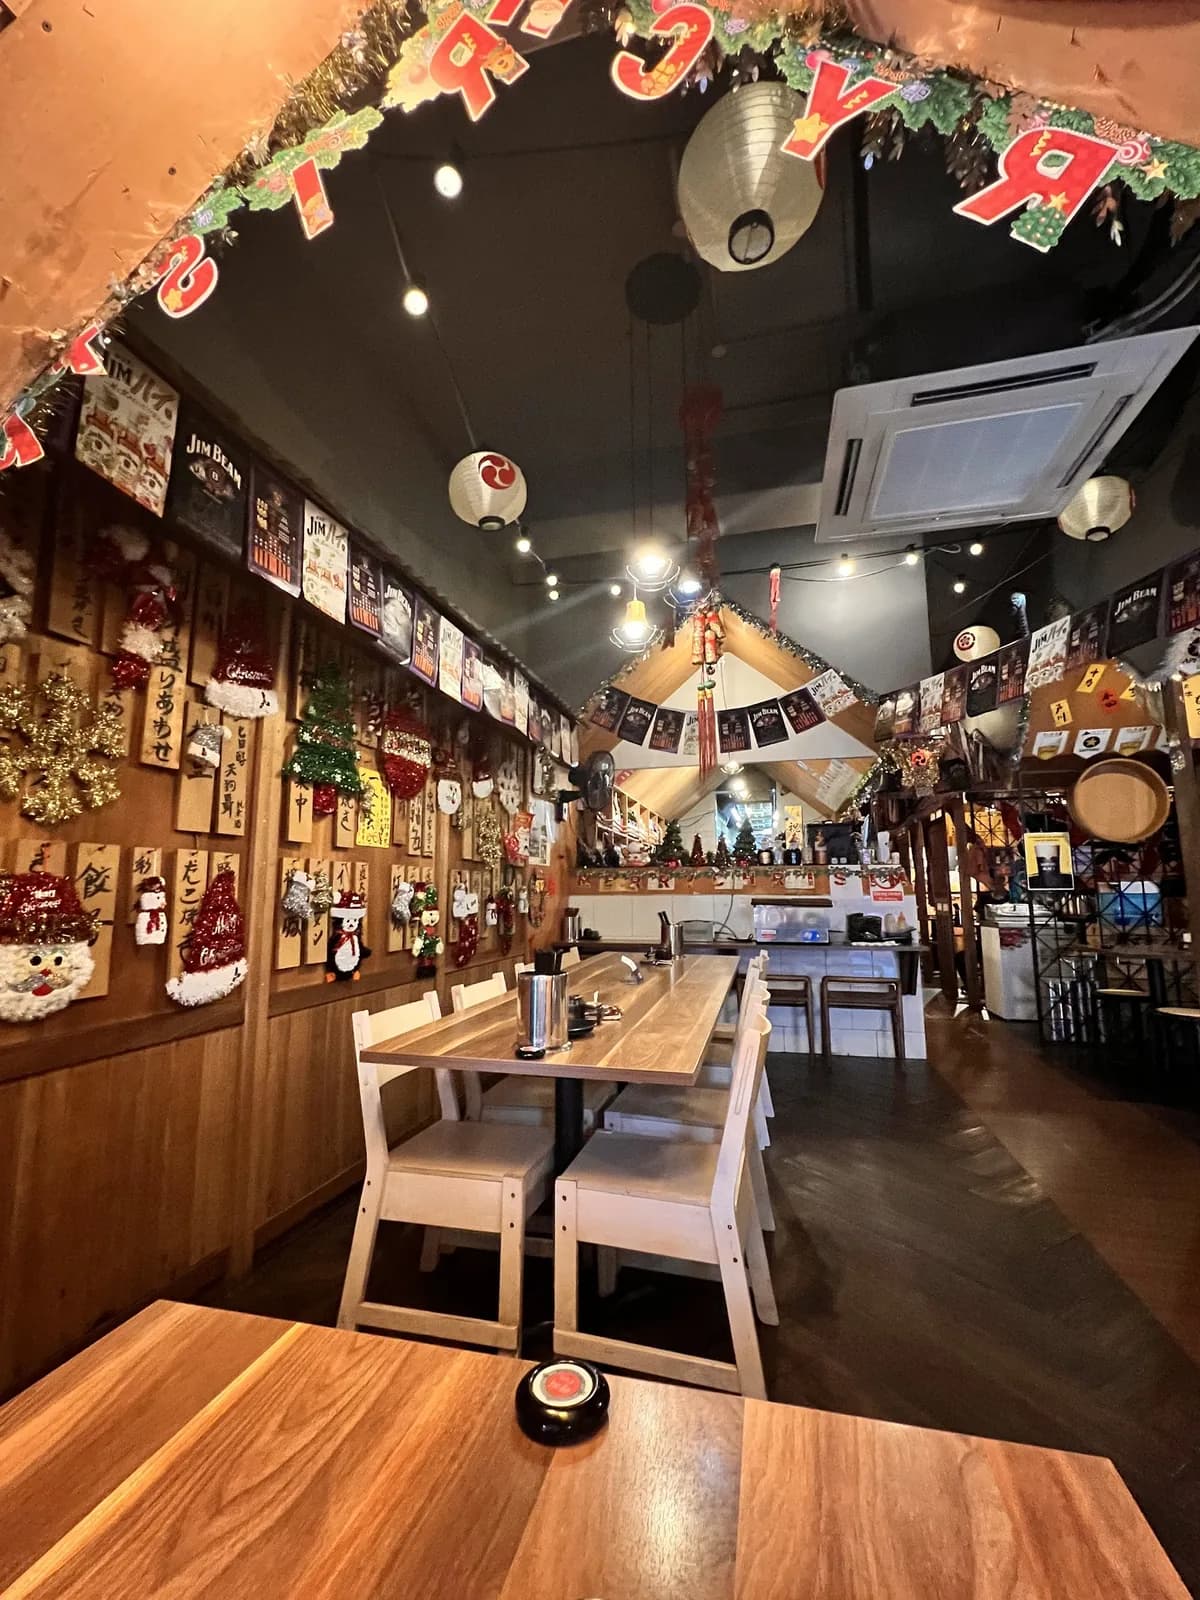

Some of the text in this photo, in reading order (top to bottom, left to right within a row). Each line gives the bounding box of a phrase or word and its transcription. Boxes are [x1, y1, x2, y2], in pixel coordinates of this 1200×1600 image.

[186, 433, 242, 490] JIM BEAM
[1114, 587, 1158, 616] JIM BEAM
[752, 711, 762, 722] JIM
